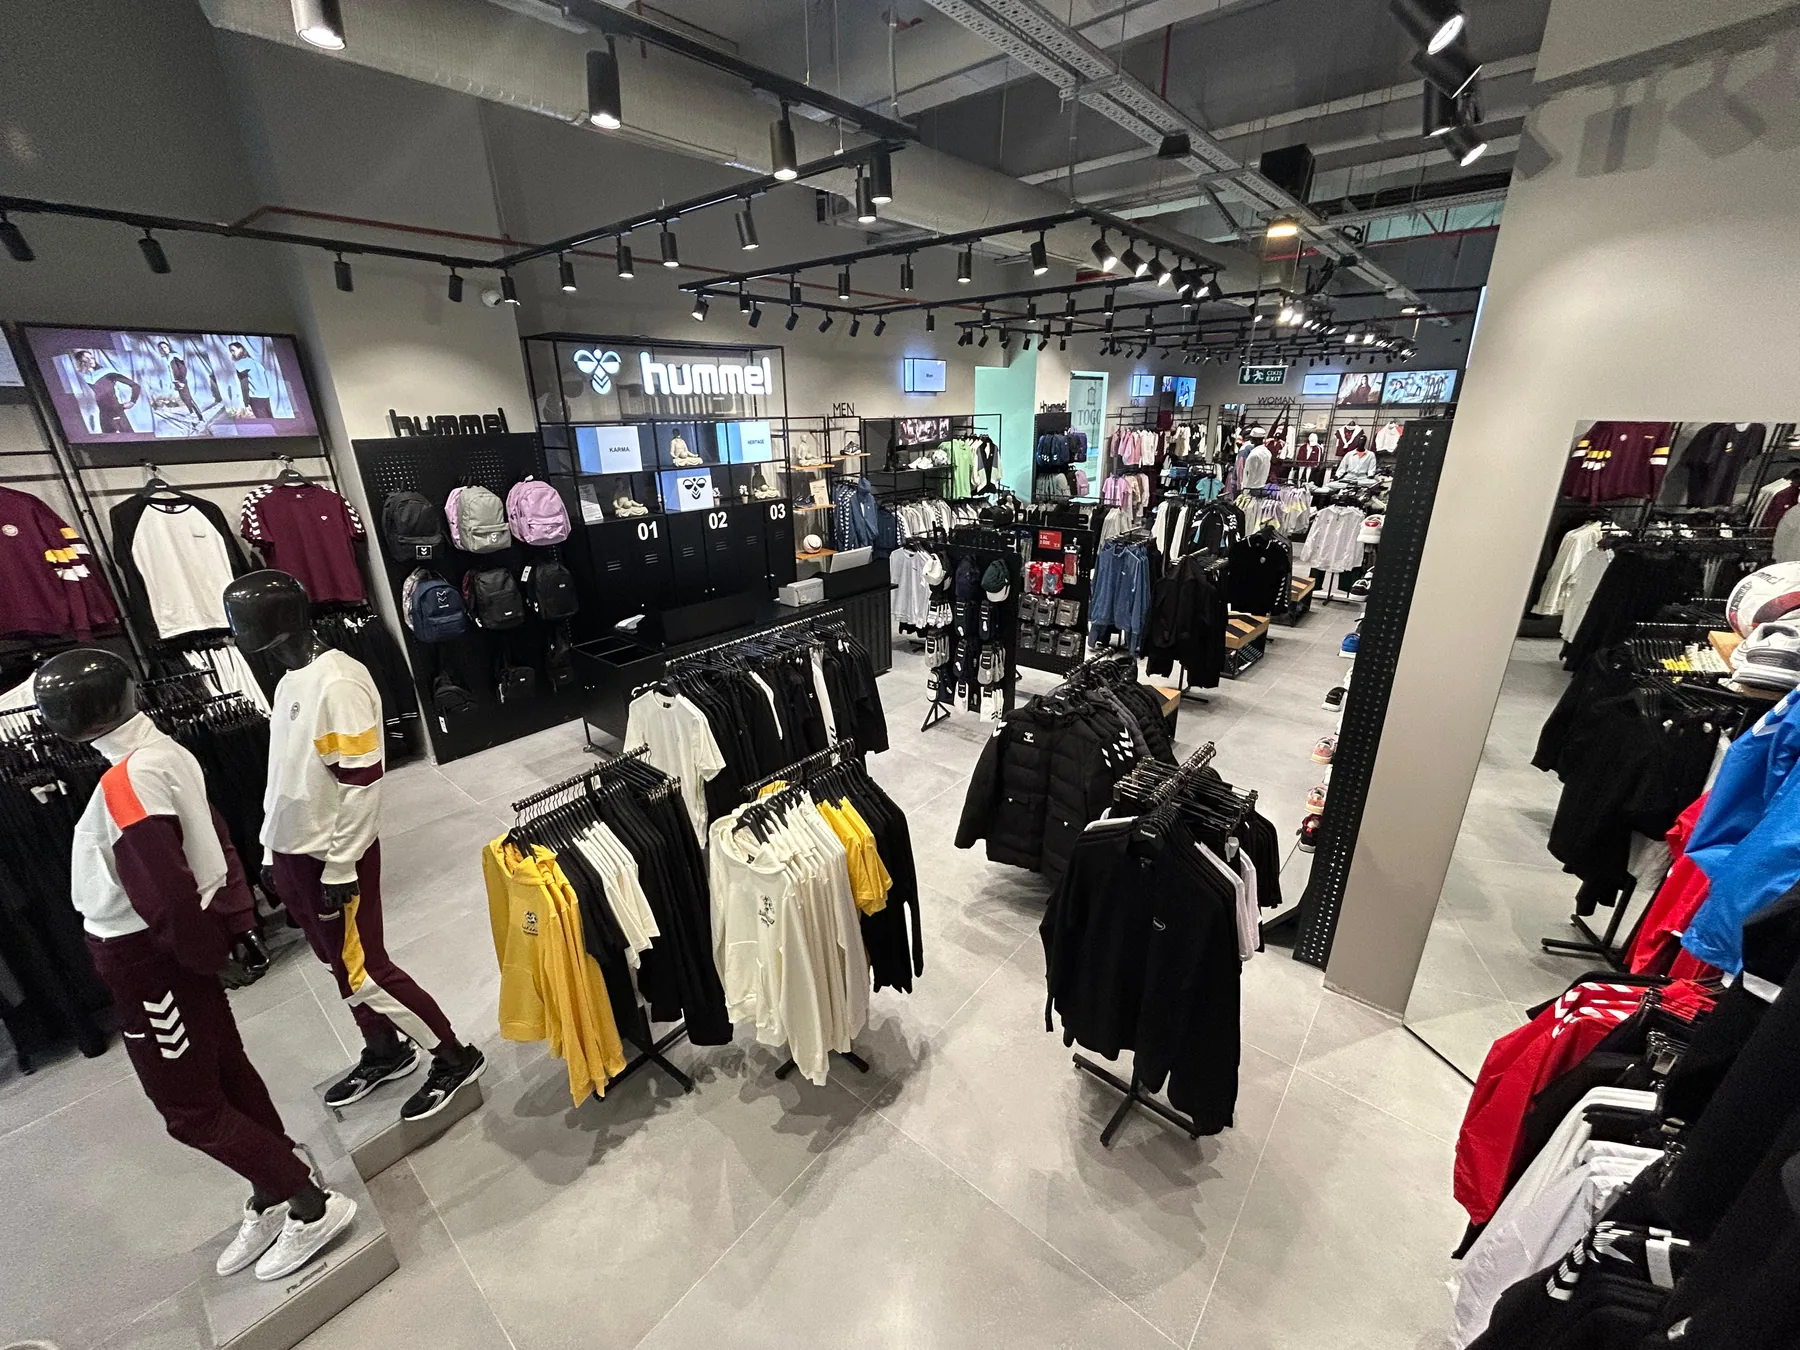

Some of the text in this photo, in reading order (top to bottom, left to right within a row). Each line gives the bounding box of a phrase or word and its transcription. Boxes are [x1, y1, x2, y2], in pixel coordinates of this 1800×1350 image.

[639, 350, 773, 396] hummel
[1258, 396, 1296, 405] WOMAN
[833, 403, 855, 417] MEN
[388, 406, 509, 438] hummel
[708, 511, 728, 529] 02
[770, 503, 786, 520] 03
[637, 521, 659, 541] 01
